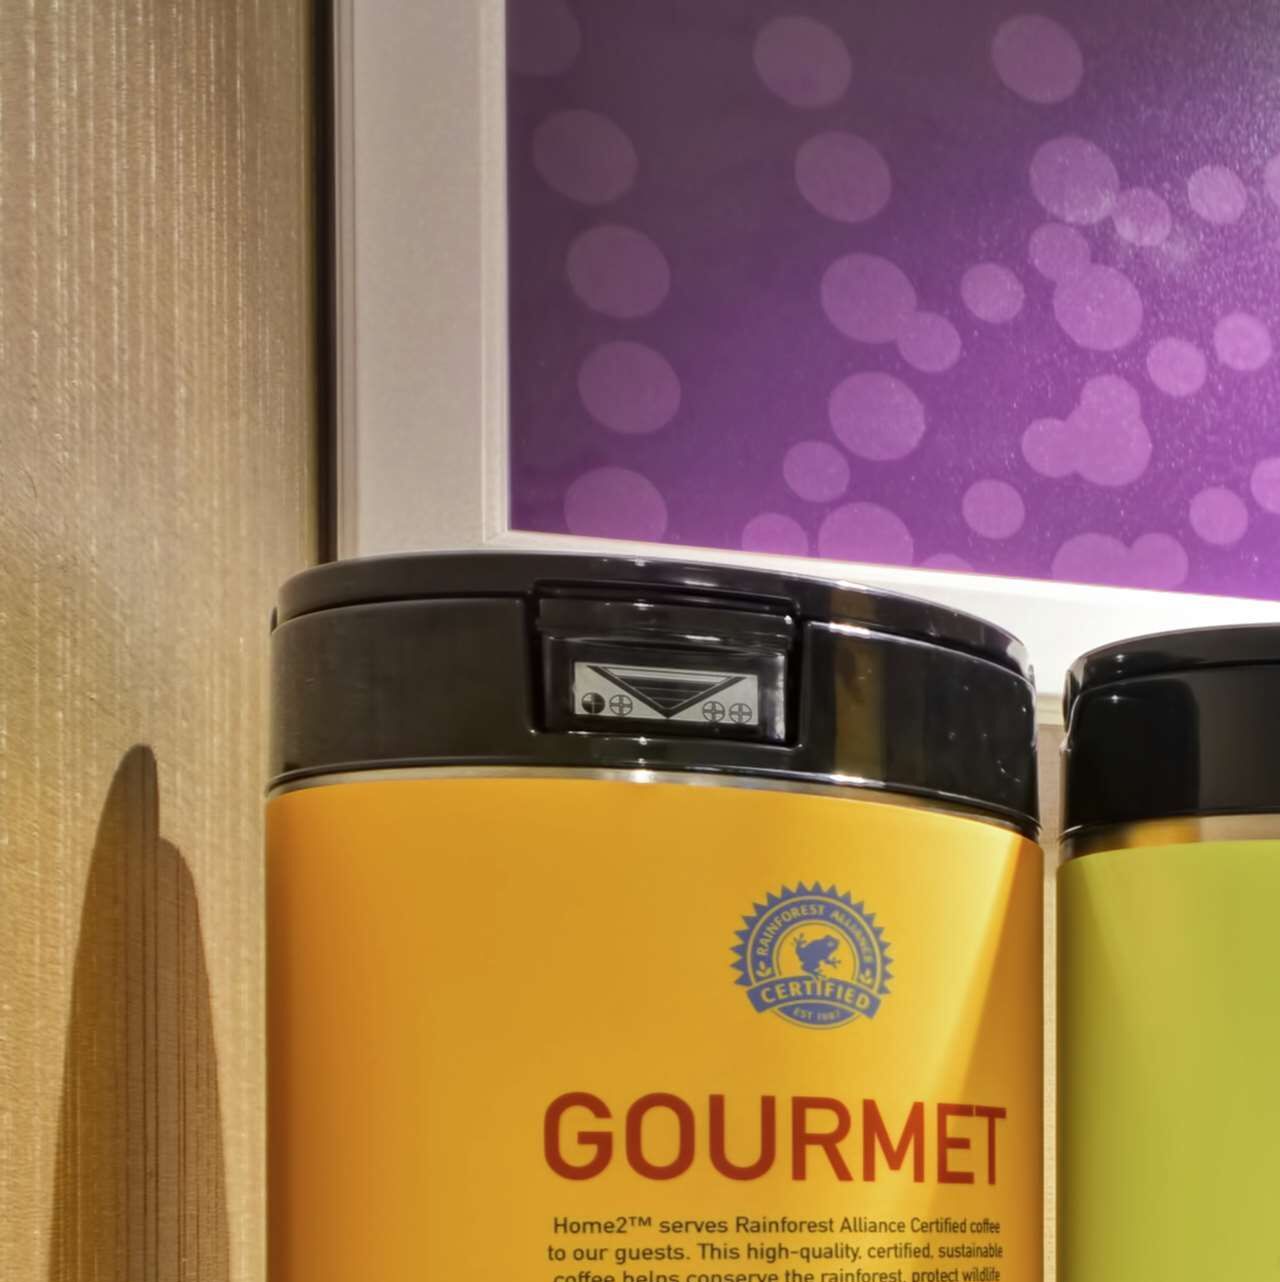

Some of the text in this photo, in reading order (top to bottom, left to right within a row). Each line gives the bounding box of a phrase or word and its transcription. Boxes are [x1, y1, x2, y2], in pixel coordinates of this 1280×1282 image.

[756, 903, 826, 956] RAINFOREST
[760, 980, 870, 1010] CERTIFIED
[544, 1091, 1006, 1186] GOURMET
[659, 1219, 729, 1234] serves
[736, 1216, 834, 1234] Rainforest
[840, 1217, 906, 1234] Alliance
[910, 1217, 967, 1234] Certified
[970, 1218, 1001, 1234] coffee
[548, 1245, 566, 1260] to
[573, 1246, 608, 1261] our
[615, 1245, 690, 1265] guests.
[697, 1242, 740, 1261] This
[938, 1243, 1004, 1259] sustainable
[963, 1267, 1000, 1282] wildlife
